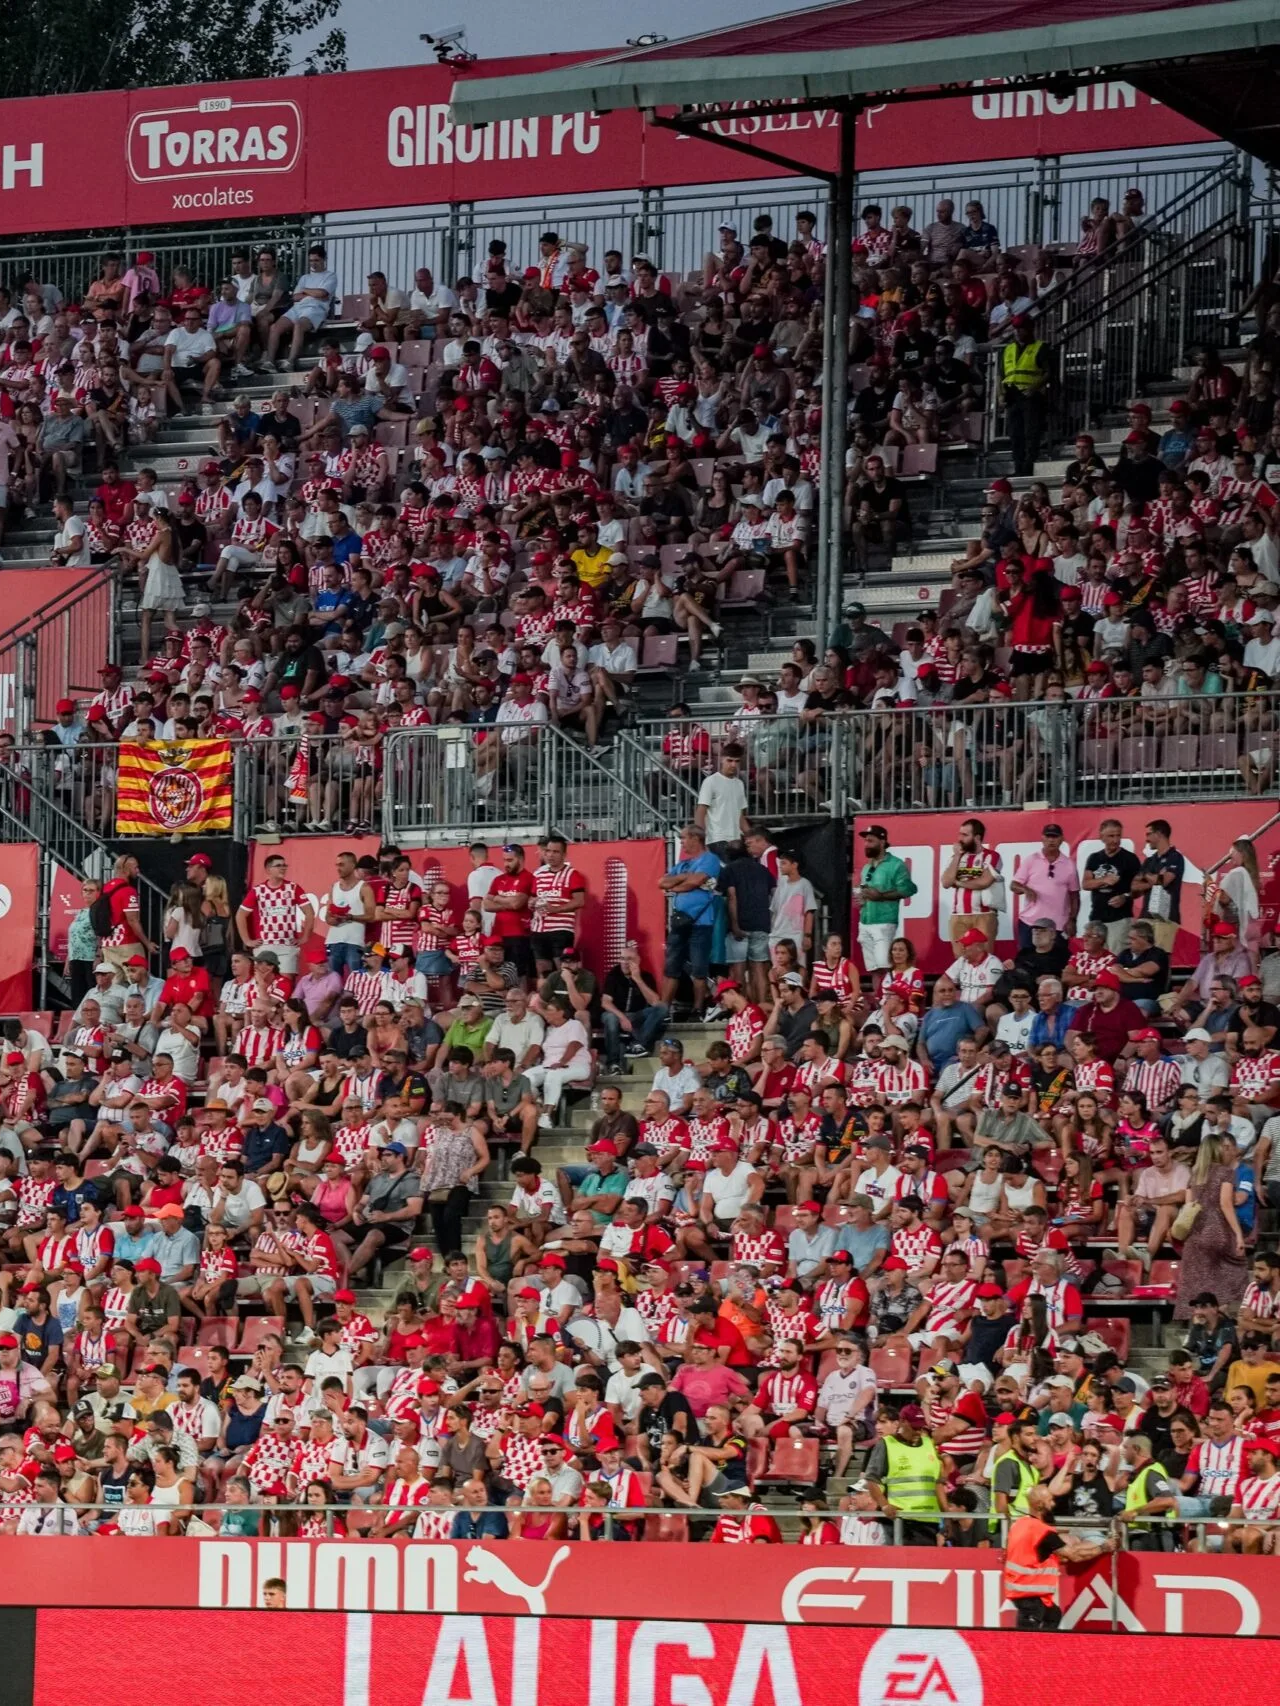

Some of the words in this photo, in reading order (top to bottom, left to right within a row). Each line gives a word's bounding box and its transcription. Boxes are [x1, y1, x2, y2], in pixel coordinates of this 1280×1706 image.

[204, 101, 226, 110] 1890
[140, 120, 288, 169] TORRAS
[172, 186, 254, 209] xocolates
[884, 1653, 959, 1703] EA
